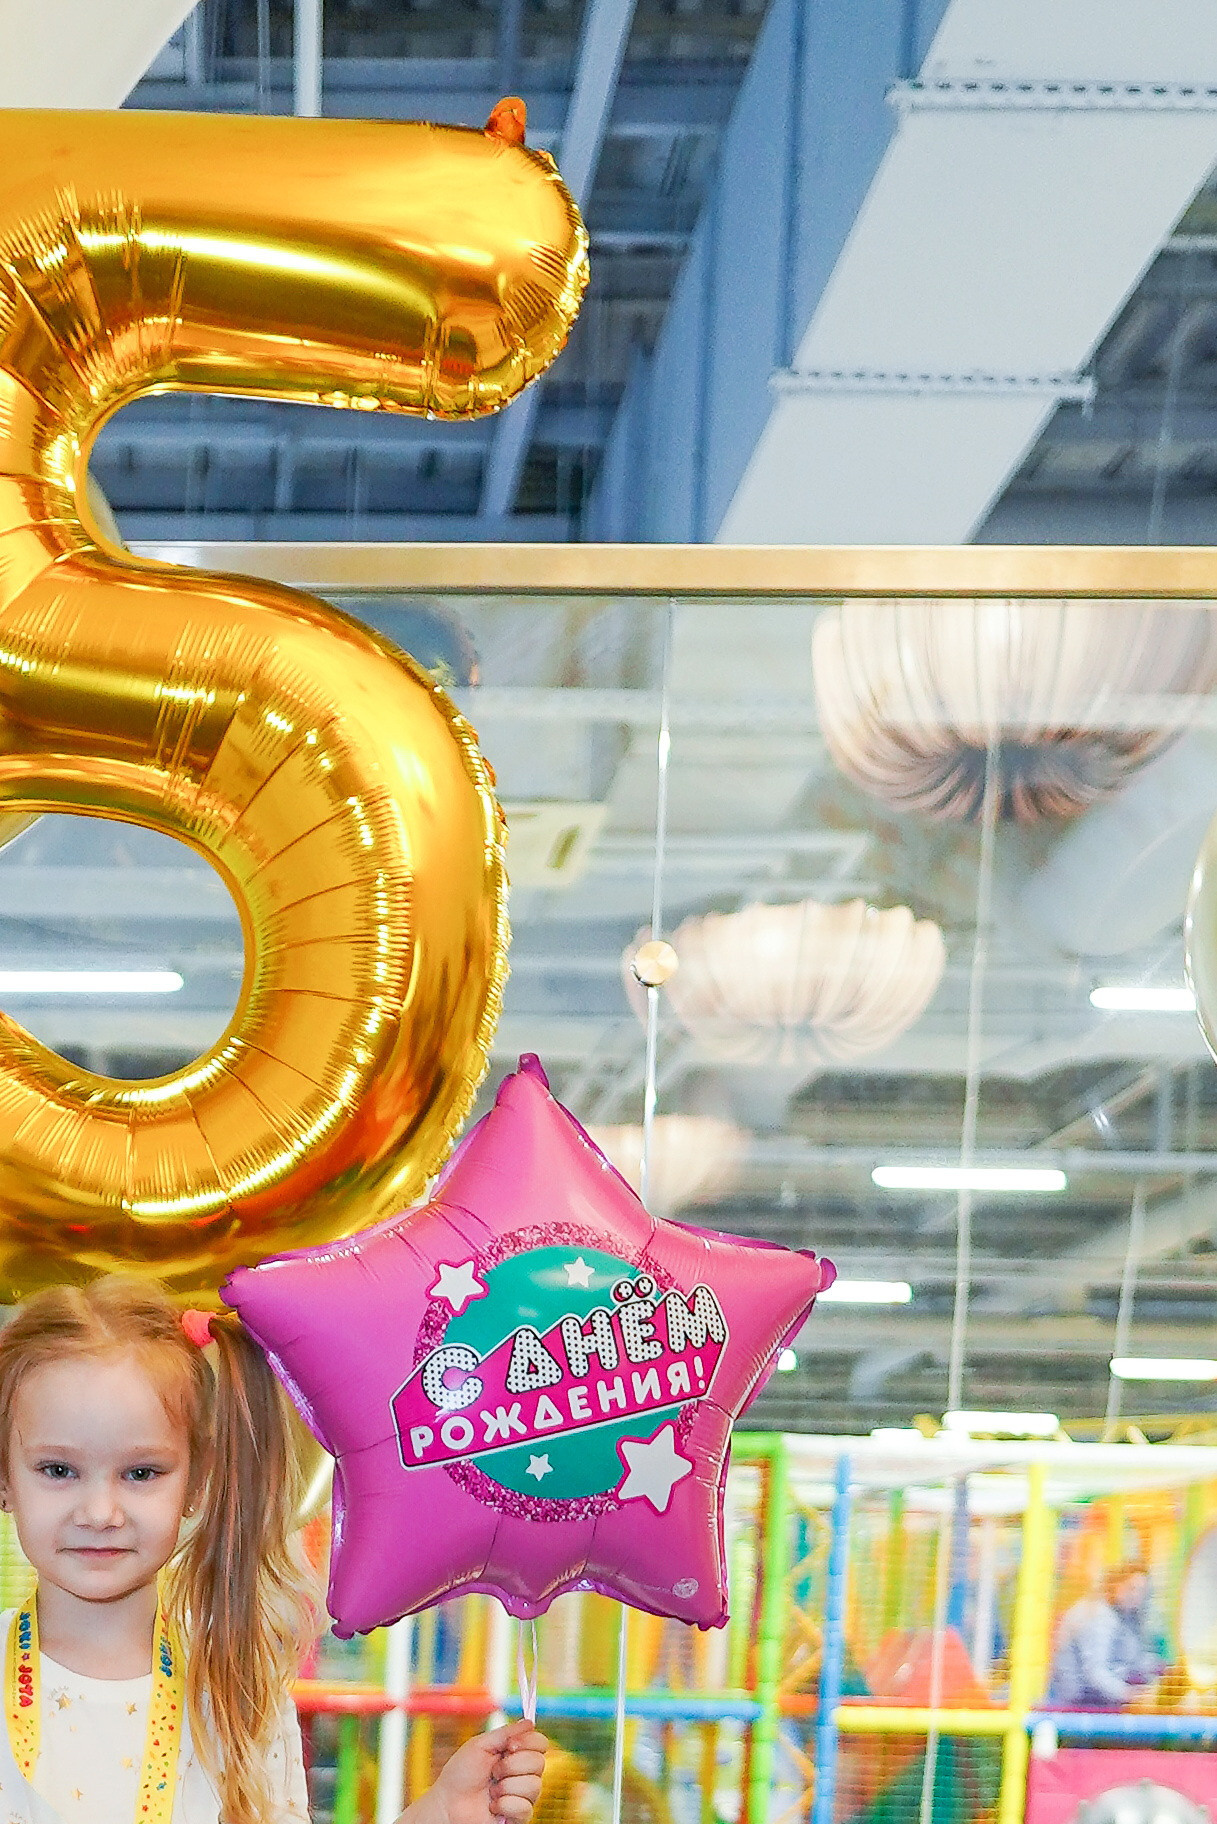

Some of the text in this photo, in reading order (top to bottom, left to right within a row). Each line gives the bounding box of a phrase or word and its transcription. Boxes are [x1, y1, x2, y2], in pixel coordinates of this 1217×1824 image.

[420, 1276, 726, 1411] С ДНЁМ
[410, 1360, 706, 1459] РОЖДЕНИЯ!
[18, 1664, 34, 1708] JOYA
